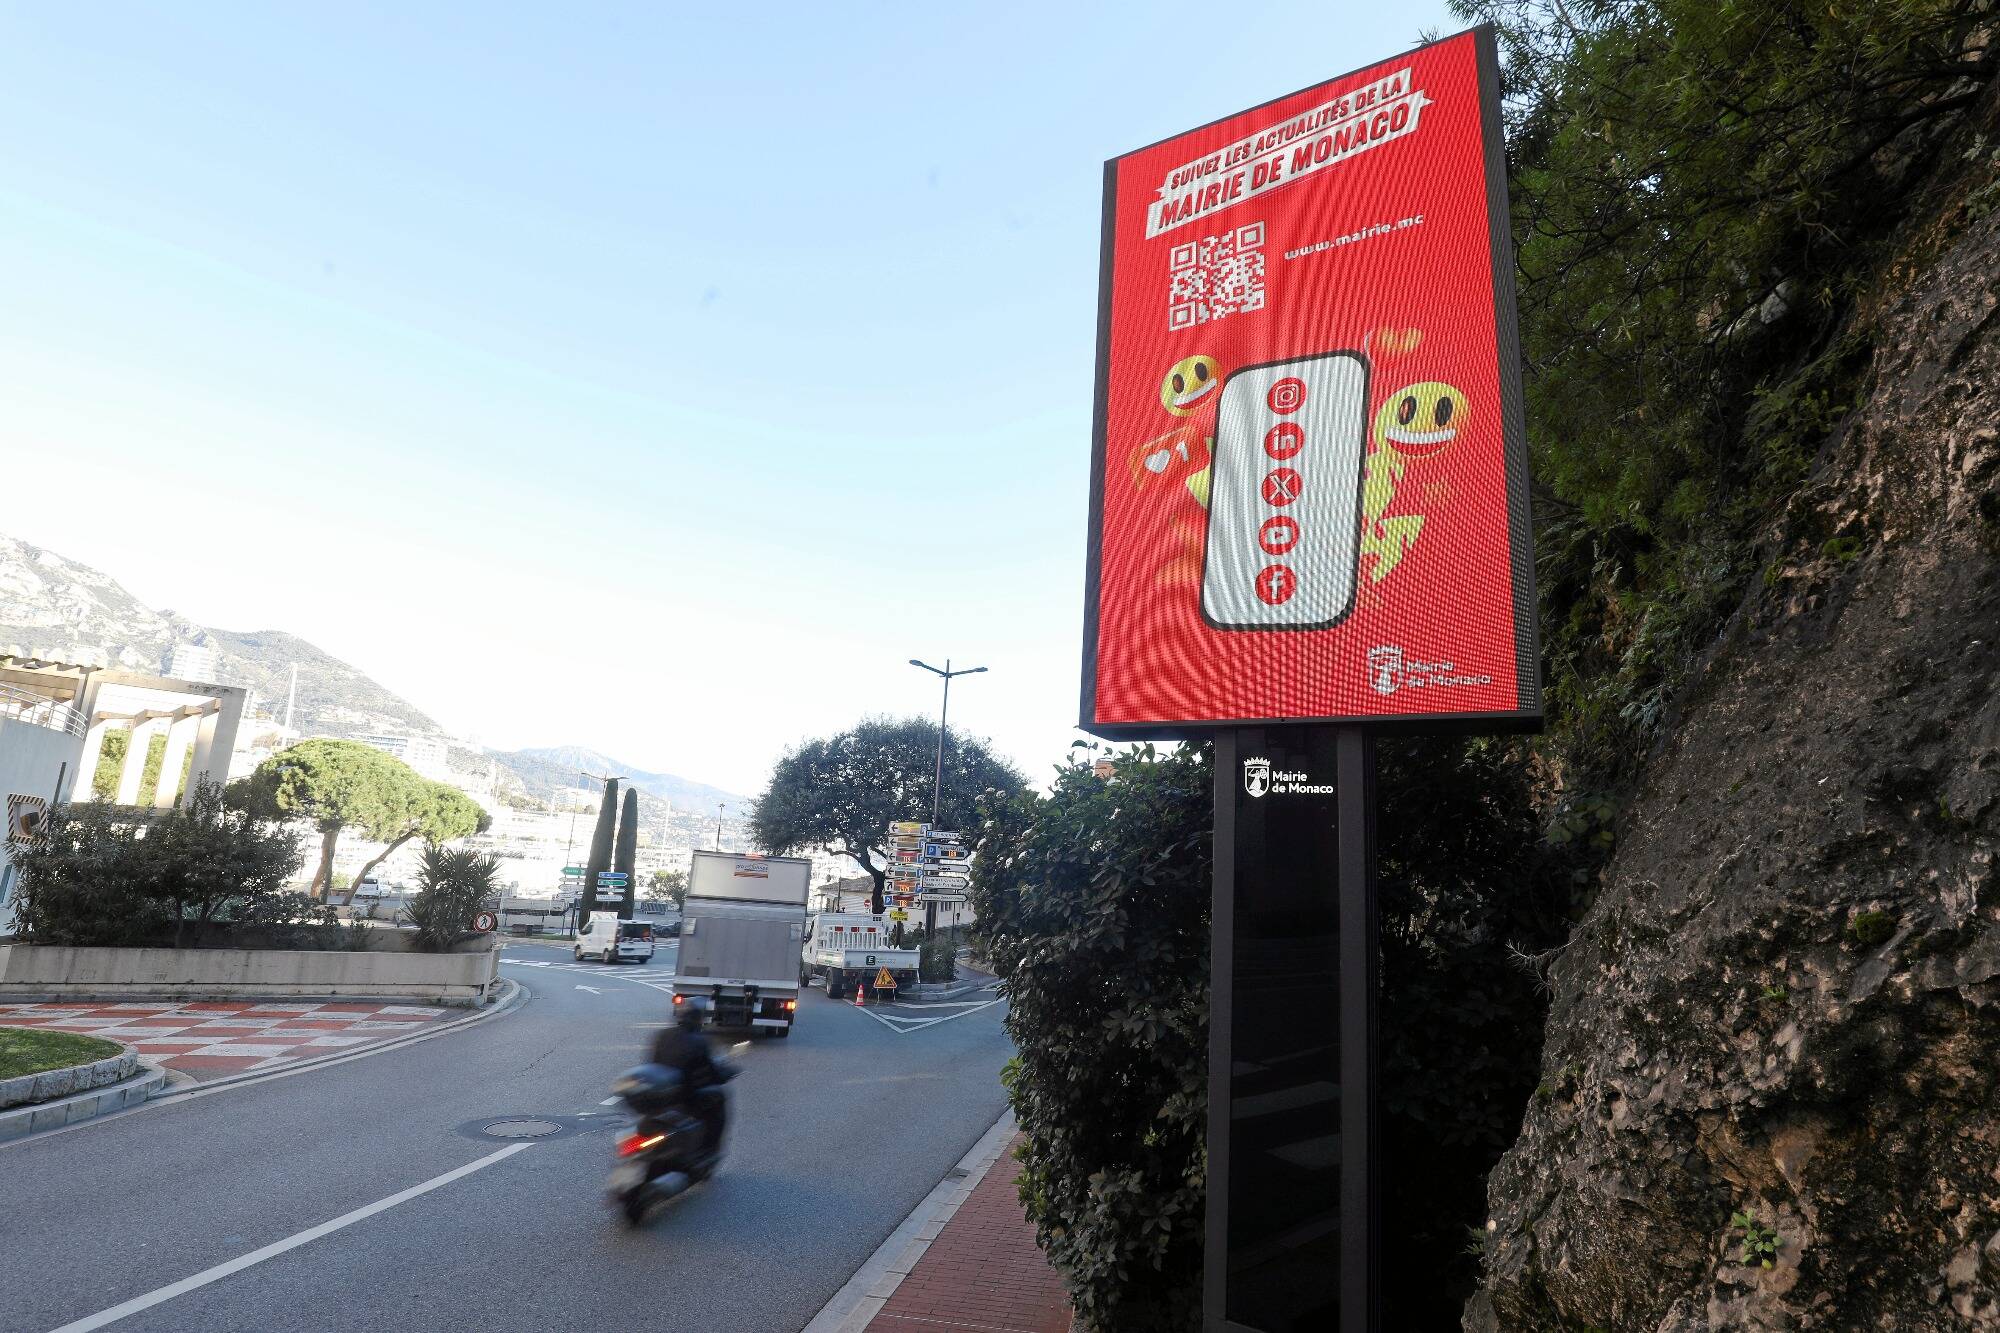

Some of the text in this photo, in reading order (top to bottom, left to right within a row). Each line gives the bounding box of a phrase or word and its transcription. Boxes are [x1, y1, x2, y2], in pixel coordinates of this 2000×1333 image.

[1170, 77, 1402, 190] SUIVEZ LES ACTUALITÉS DE LA
[1158, 102, 1410, 229] MAIRIE DE MONACO
[1284, 214, 1424, 260] www.mairie.mc
[1273, 430, 1296, 451] in
[1272, 771, 1308, 782] Mairie
[1272, 783, 1334, 794] de Monaco
